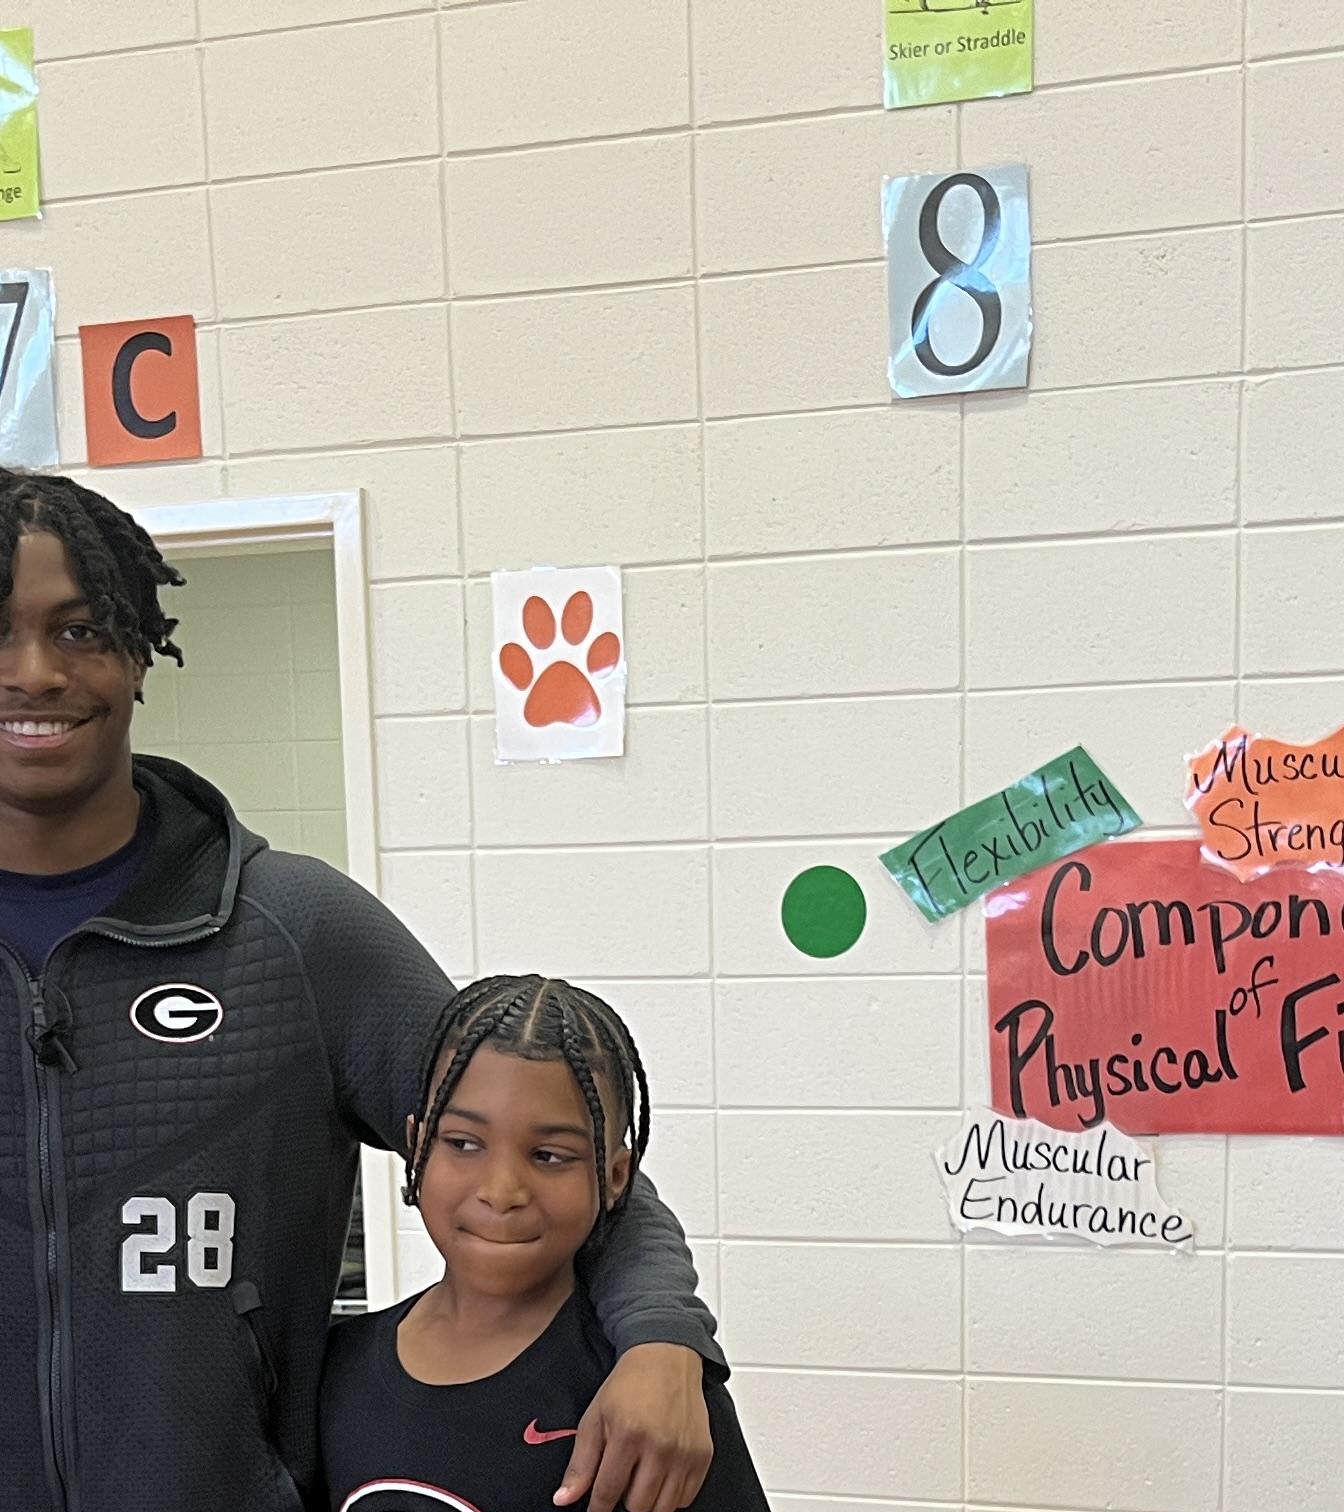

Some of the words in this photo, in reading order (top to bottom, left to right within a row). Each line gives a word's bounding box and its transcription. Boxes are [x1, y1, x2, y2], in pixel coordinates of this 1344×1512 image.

[888, 43, 930, 60] Skier
[934, 41, 952, 55] or
[957, 28, 1026, 52] Straddle
[911, 172, 1002, 376] 8
[111, 331, 177, 440] C
[908, 761, 1125, 916] Flexibility
[1229, 956, 1279, 1018] of
[994, 999, 1238, 1127] Physical
[945, 1119, 1151, 1181] Muscular
[122, 1192, 236, 1293] 28
[960, 1176, 1193, 1243] Endurance
